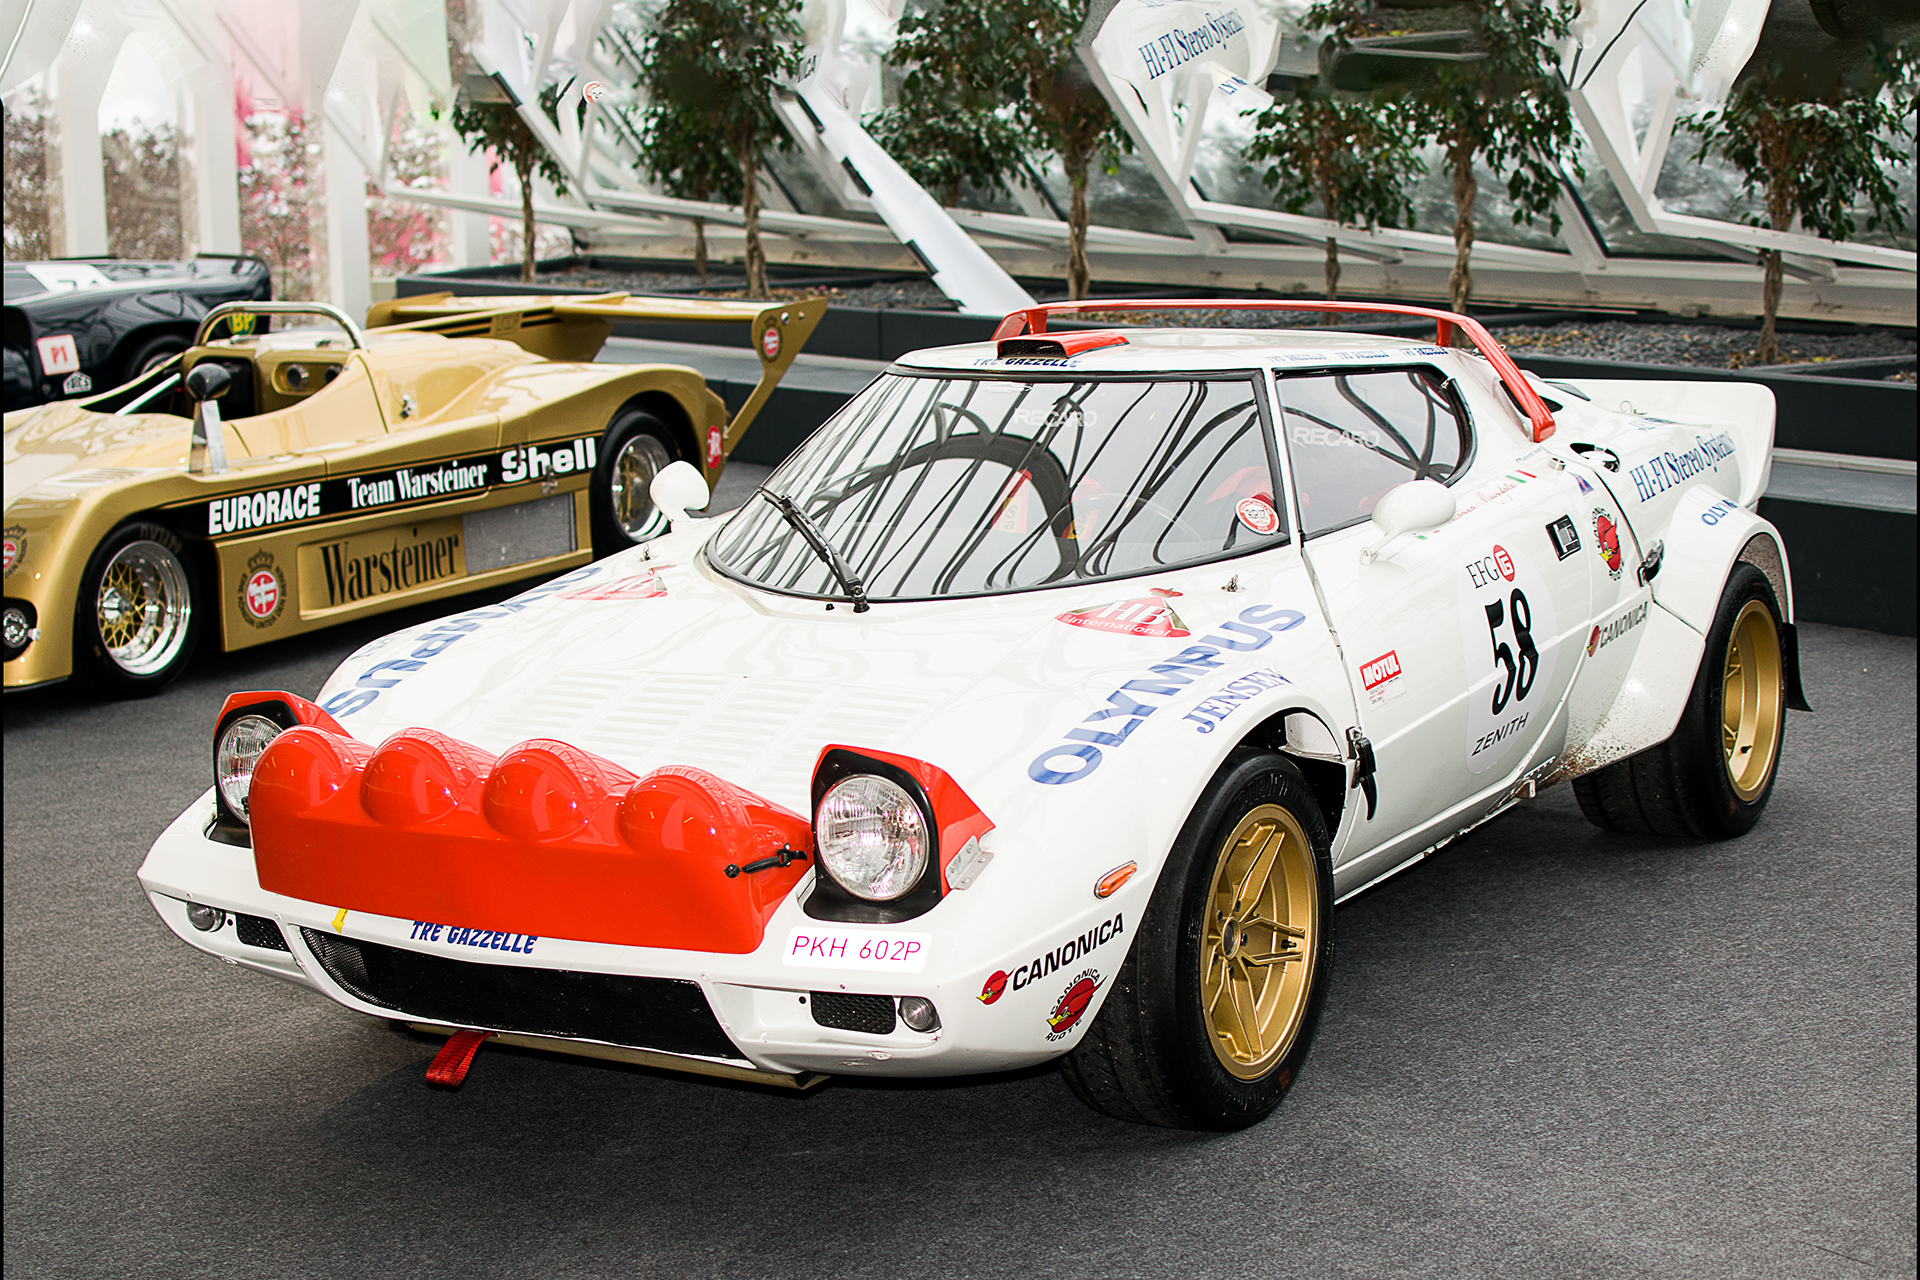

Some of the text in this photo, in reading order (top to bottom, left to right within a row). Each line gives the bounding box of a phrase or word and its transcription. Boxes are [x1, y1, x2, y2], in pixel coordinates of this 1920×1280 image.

[1138, 33, 1182, 80] HI-FI
[1173, 25, 1214, 61] Stereo
[231, 312, 254, 332] BP
[51, 345, 68, 365] P1
[1004, 358, 1082, 368] GAZZELLE
[1013, 408, 1098, 428] RECARO
[1292, 426, 1381, 448] RECARO
[208, 437, 597, 535] EURORACE Team Warsteiner Shell
[1628, 456, 1673, 503] HI-FI
[1664, 447, 1705, 485] Stereo
[318, 527, 460, 607] Warsteiner
[1465, 556, 1500, 589] EFG
[1067, 616, 1171, 637] International
[1094, 600, 1174, 626] HB
[1600, 600, 1649, 649] CANONICA
[1484, 588, 1539, 716] 58
[1362, 653, 1400, 687] MOTUL
[1028, 604, 1306, 785] OLYMPUS
[1182, 668, 1293, 734] JENSEN
[1471, 712, 1530, 757] ZENITH
[410, 920, 539, 955] TRE GAZZELLE
[792, 935, 921, 961] PKH 602P
[1012, 912, 1124, 991] CANONICA
[1049, 968, 1101, 1015] CANONICA
[1044, 1018, 1083, 1042] RUOTE
